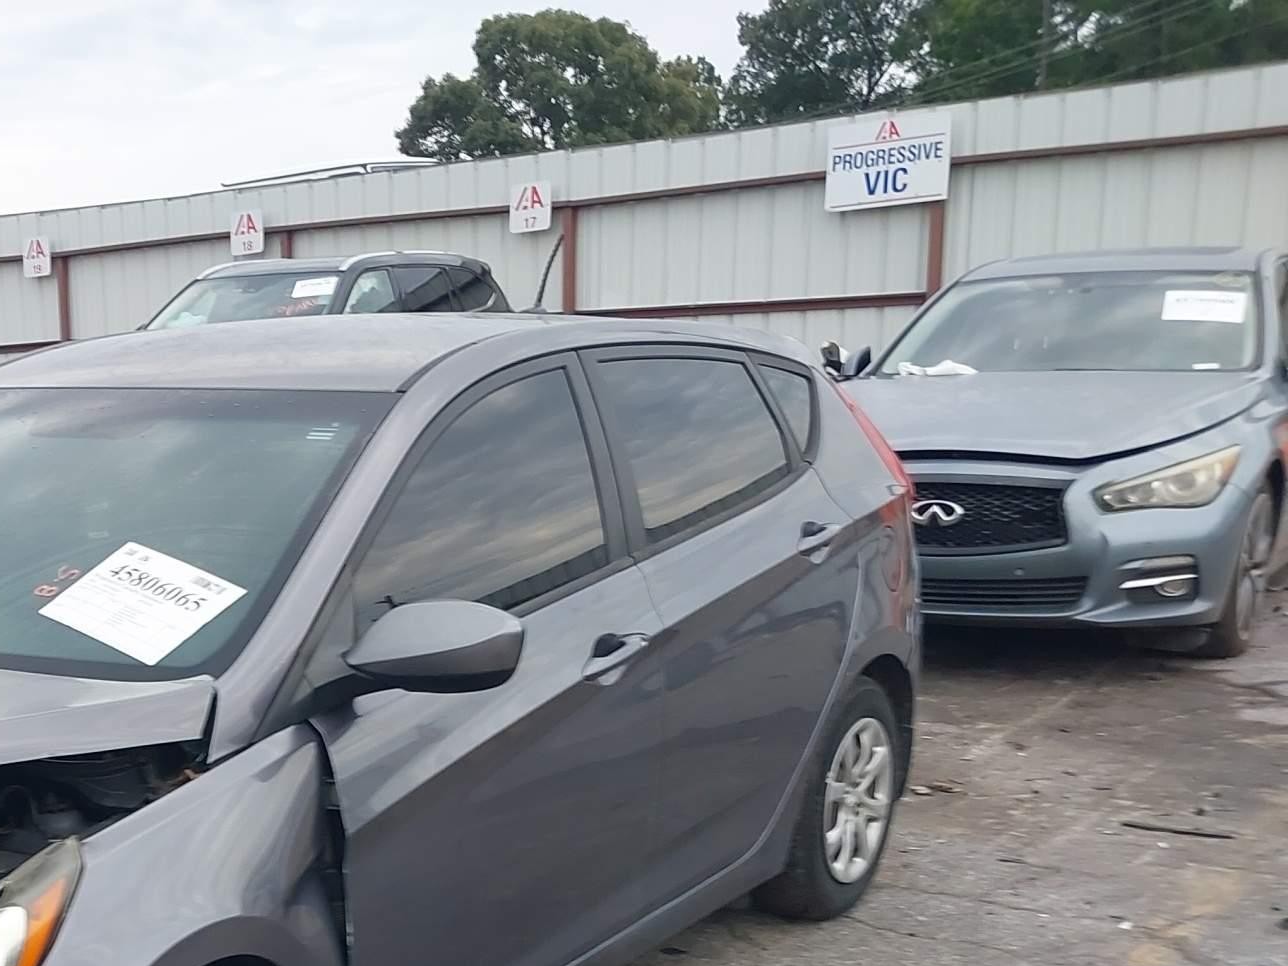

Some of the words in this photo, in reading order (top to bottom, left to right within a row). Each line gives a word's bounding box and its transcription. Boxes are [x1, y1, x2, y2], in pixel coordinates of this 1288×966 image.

[832, 141, 944, 173] PROGRESSIVE
[864, 167, 909, 195] VIC
[524, 216, 538, 229] 17
[109, 564, 208, 612] 45806065
